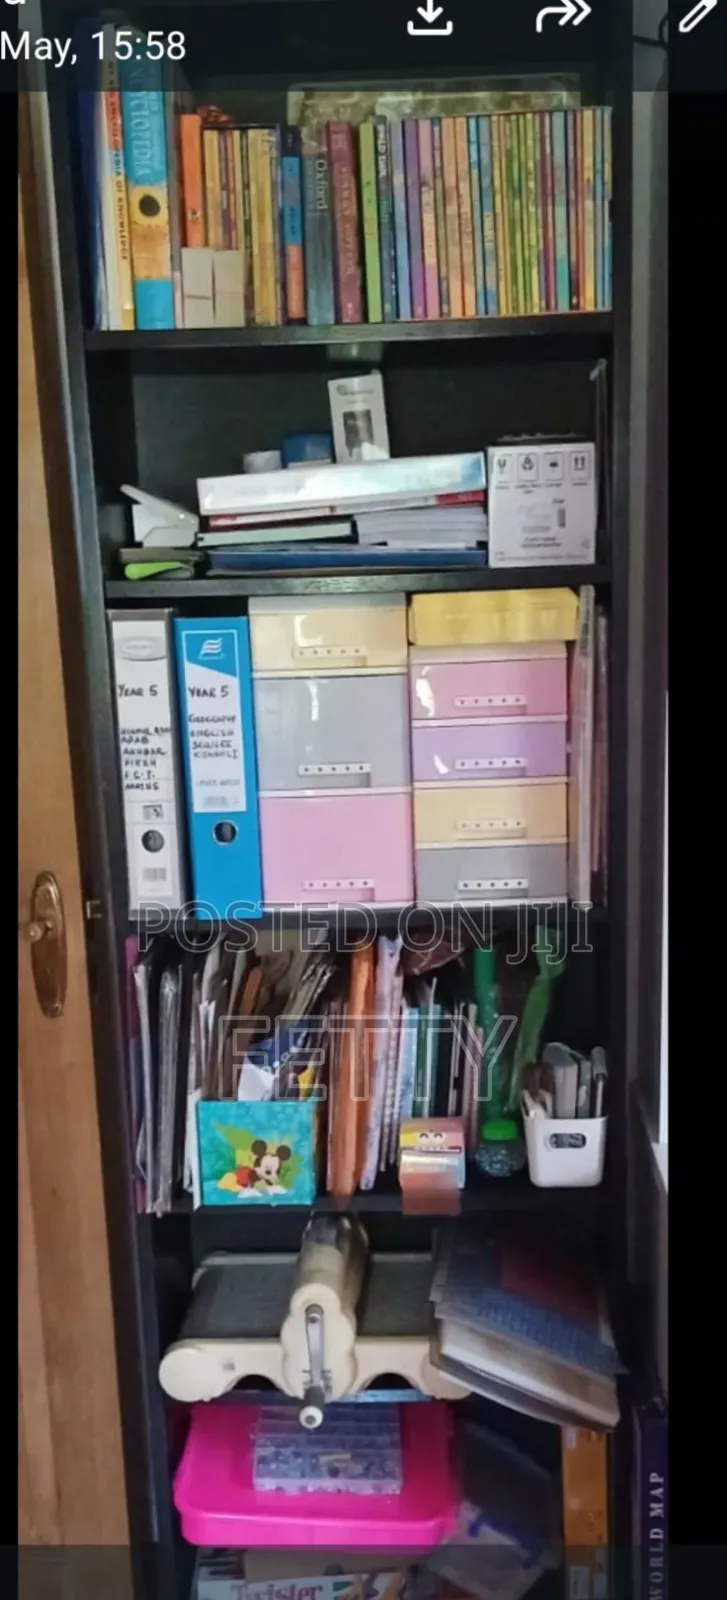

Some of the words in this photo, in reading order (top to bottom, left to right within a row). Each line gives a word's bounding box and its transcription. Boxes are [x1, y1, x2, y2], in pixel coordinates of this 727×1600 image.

[315, 160, 328, 210] Oxford
[118, 684, 144, 697] YEAR
[149, 684, 158, 697] 5
[188, 685, 216, 698] YEAR
[220, 685, 229, 698] 5
[190, 730, 235, 738] ENGLISH
[650, 1472, 664, 1518] MAP
[650, 1528, 664, 1600] WORLD
